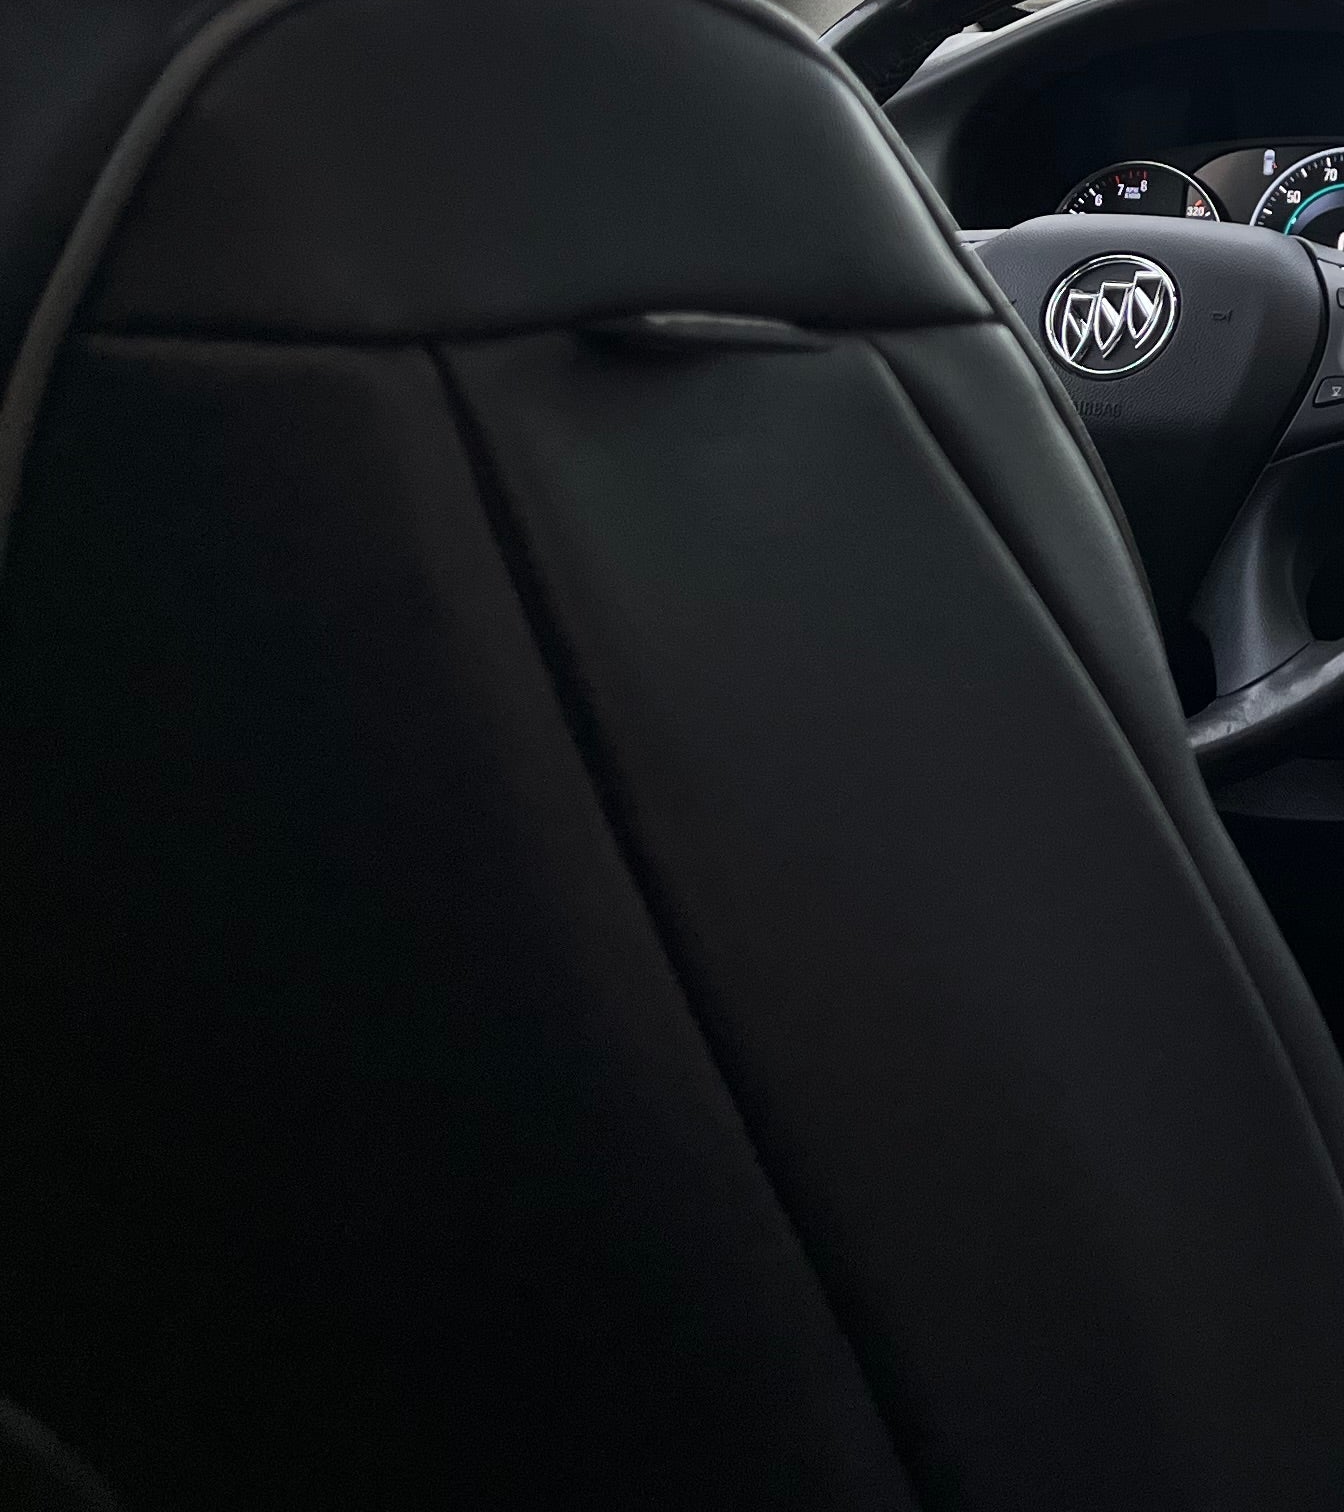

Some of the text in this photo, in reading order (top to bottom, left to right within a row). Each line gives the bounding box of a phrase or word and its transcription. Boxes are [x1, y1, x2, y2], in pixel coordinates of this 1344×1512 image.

[1324, 167, 1338, 182] 70
[1117, 183, 1125, 196] 7
[1094, 194, 1103, 207] 6
[1286, 190, 1301, 204] 50
